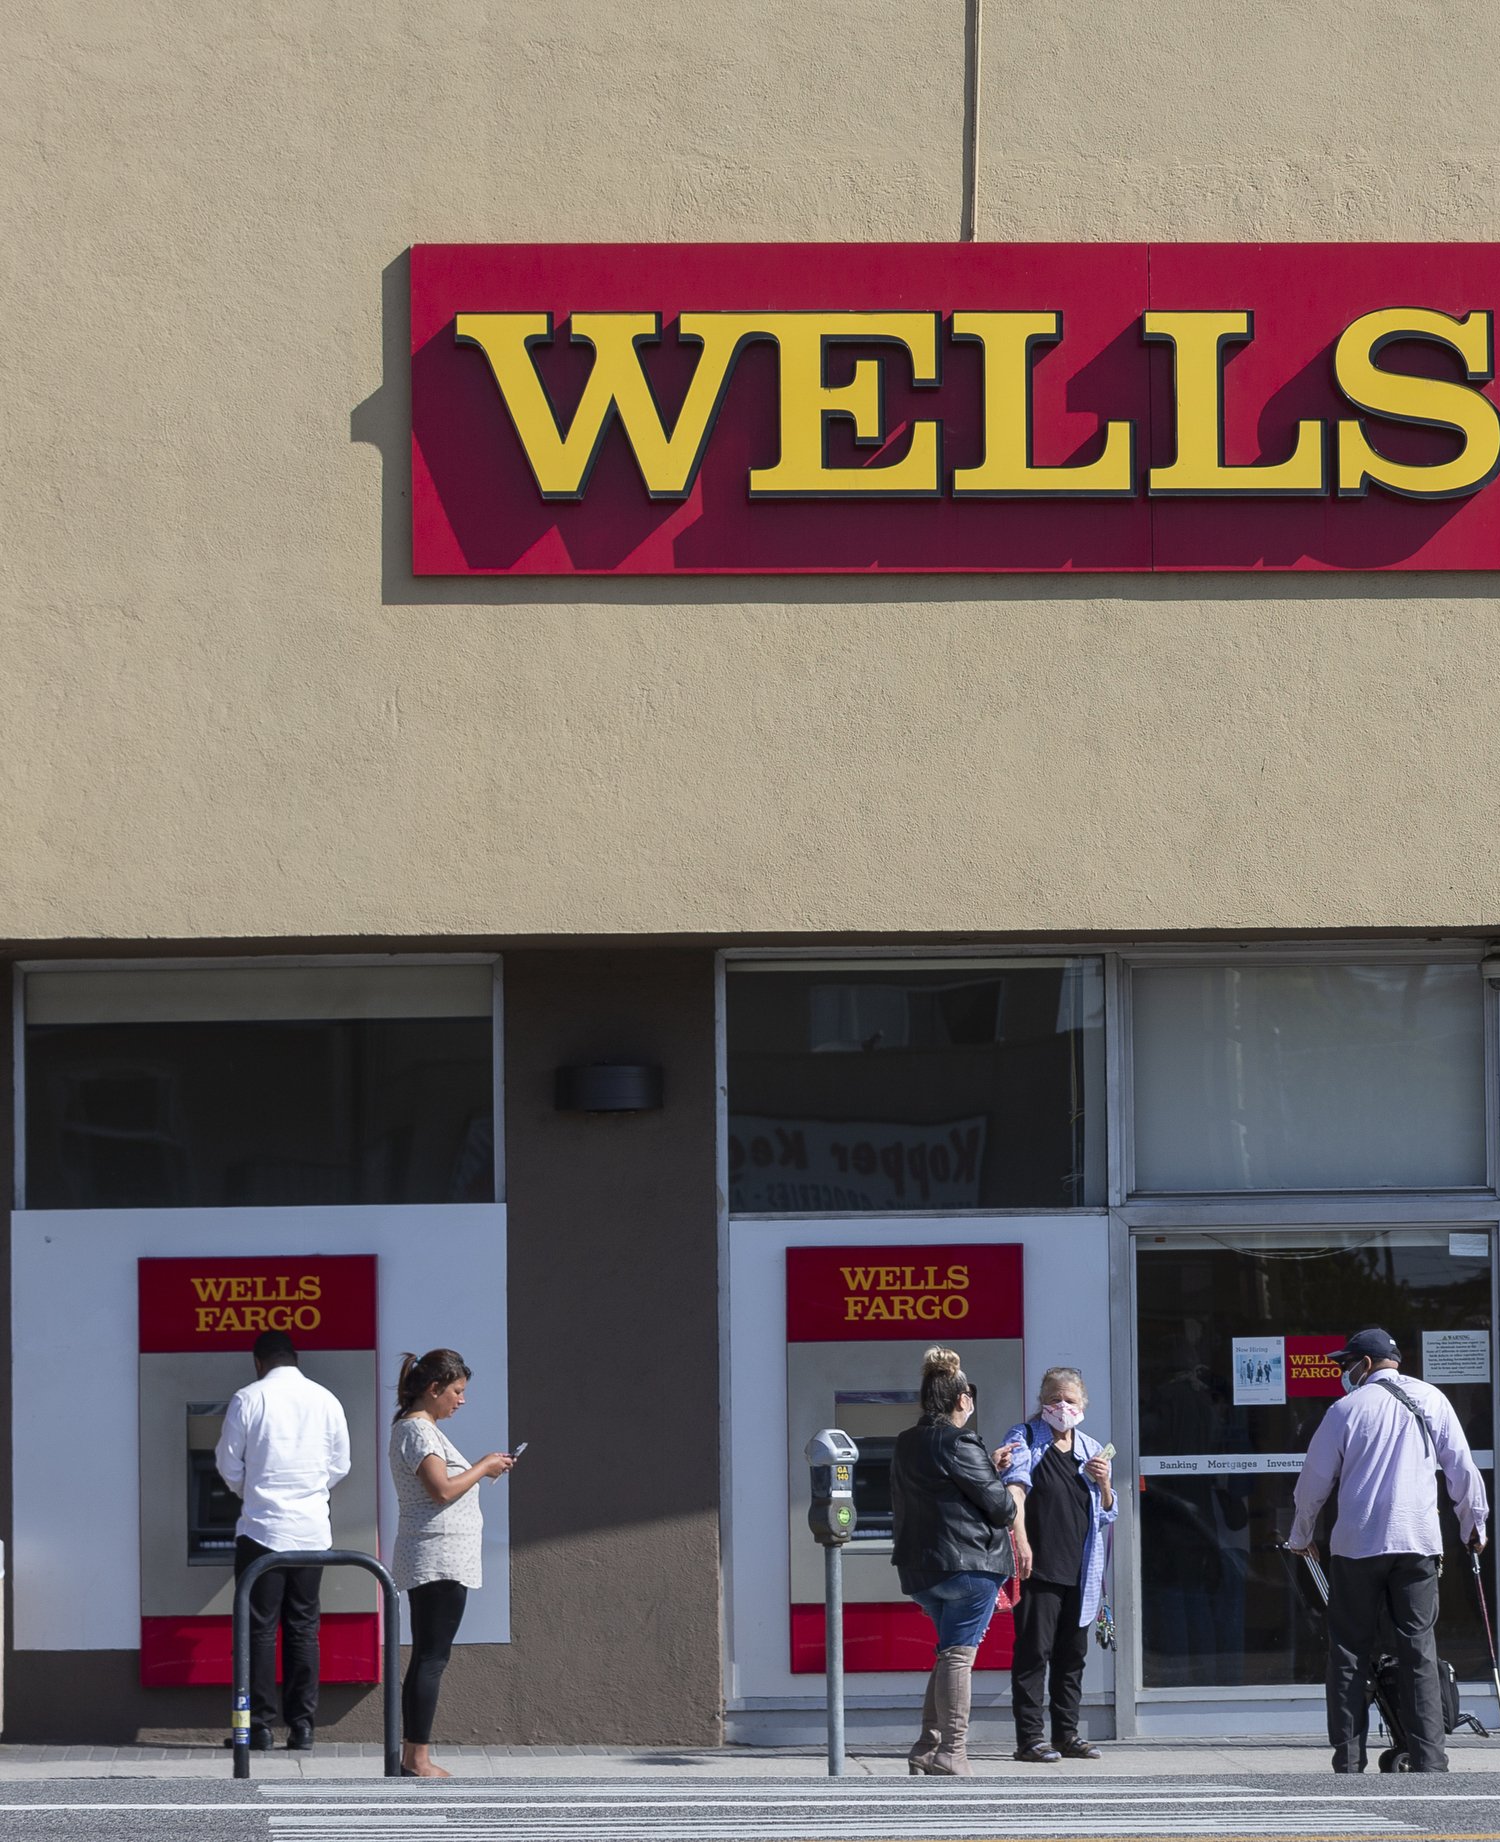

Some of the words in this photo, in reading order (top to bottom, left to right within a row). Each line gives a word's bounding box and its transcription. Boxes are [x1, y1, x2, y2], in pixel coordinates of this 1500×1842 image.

[191, 1276, 321, 1302] WELLS
[841, 1265, 969, 1291] WELLS
[195, 1306, 321, 1331] FARGO
[845, 1295, 969, 1321] FARGO
[1291, 1367, 1342, 1379] FARGO
[1160, 1461, 1198, 1470] Banking
[1208, 1460, 1257, 1470] Mortgages
[1267, 1459, 1304, 1468] Investm
